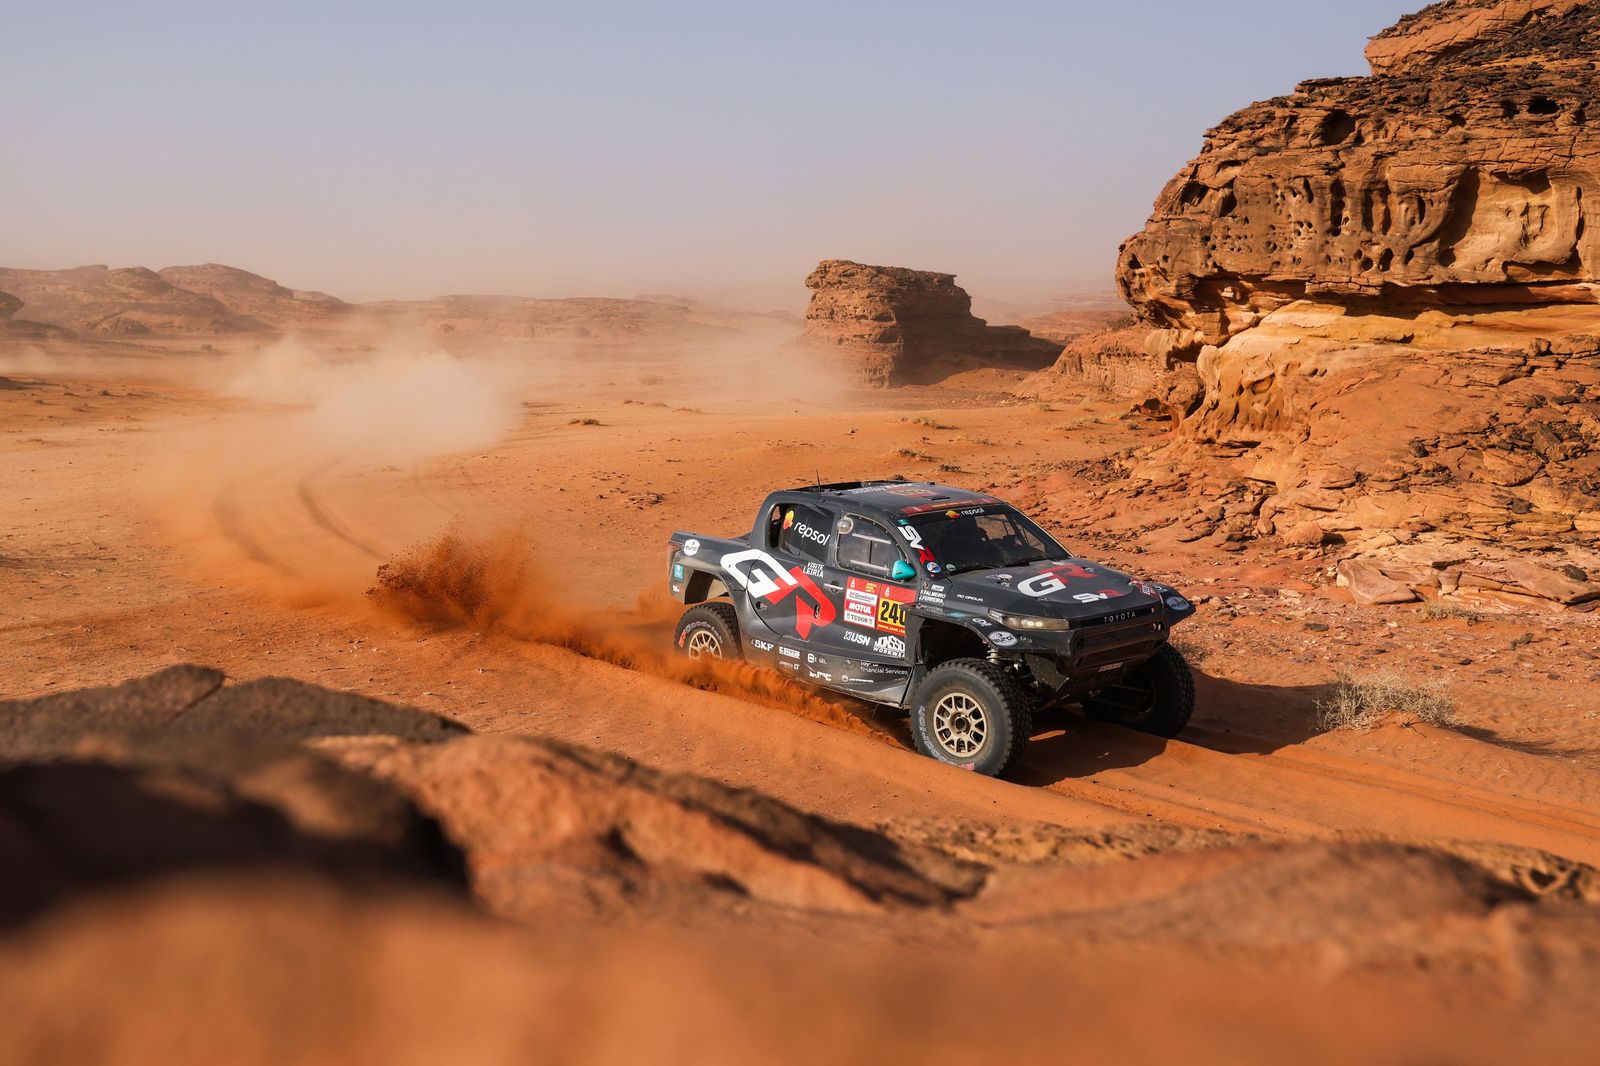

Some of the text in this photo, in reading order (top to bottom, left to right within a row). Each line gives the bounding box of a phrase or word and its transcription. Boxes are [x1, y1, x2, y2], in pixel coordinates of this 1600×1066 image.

[961, 508, 987, 516] repsol
[794, 522, 831, 546] repsol
[802, 566, 824, 579] LEIRIA
[1017, 564, 1098, 598] GR
[720, 549, 836, 640] GR
[848, 602, 872, 614] MOTUL
[851, 613, 869, 624] TUDOR
[1103, 611, 1136, 623] TOYOTA
[754, 639, 774, 652] SKF
[851, 633, 871, 647] USN
[873, 635, 906, 653] JONSSO
